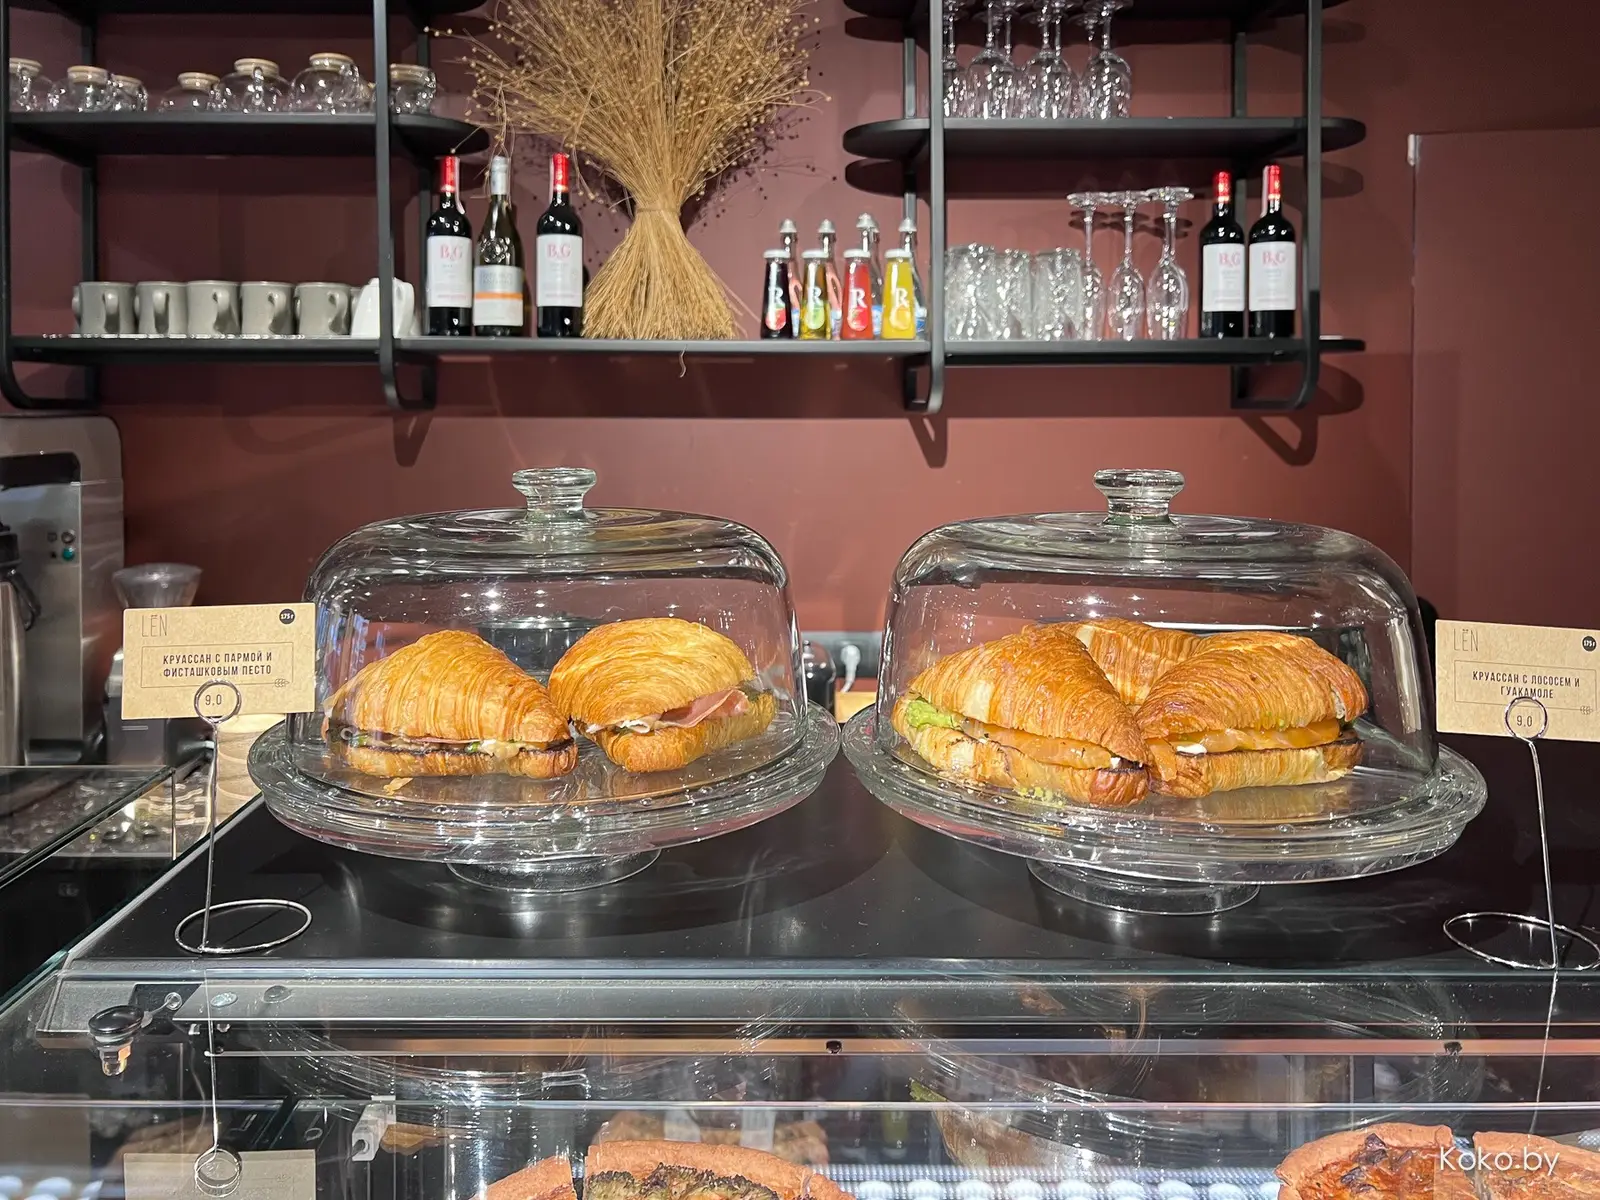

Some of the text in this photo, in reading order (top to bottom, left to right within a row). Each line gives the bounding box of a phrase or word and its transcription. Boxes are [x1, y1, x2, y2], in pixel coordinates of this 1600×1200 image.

[163, 651, 272, 665] КРУАССАН С ПАРМОЙ И
[163, 665, 272, 677] ФИСТАШКОВЫМ ПЕСТО
[1472, 671, 1580, 688] КРУАССАН С ЛОСОСЕМ И
[1500, 686, 1554, 699] ГУАКАМОЛЕ
